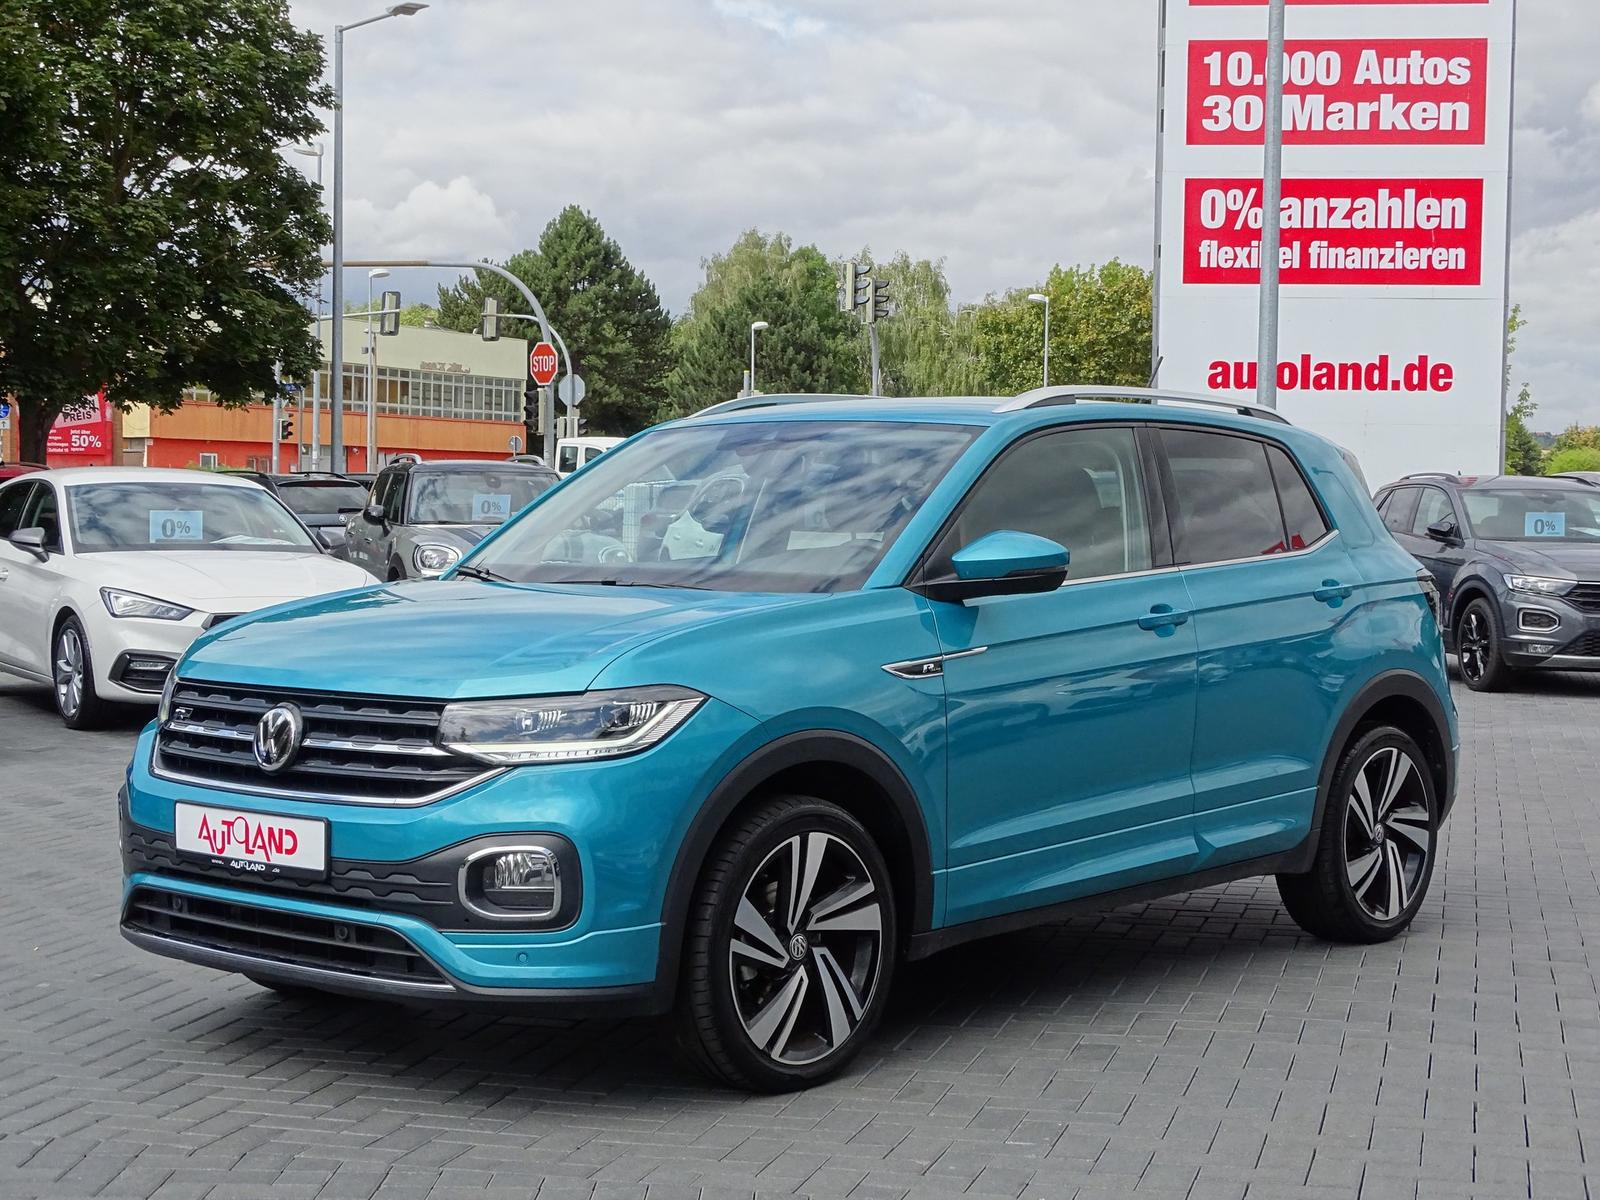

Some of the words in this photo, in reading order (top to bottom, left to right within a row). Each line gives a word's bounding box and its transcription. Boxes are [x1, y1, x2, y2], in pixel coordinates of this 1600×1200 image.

[1353, 49, 1471, 85] Autos
[1202, 94, 1263, 131] 30
[1281, 94, 1470, 131] Marken
[1200, 187, 1263, 230] 0%
[1280, 188, 1467, 229] anzahlen
[1199, 240, 1300, 268] flexiel
[1309, 240, 1466, 270] finanzieren
[532, 355, 555, 372] STOP
[1207, 353, 1454, 391] auoland.de
[71, 435, 102, 448] 50%
[481, 500, 502, 514] 0%
[161, 518, 191, 538] 0%
[1534, 519, 1556, 535] 0%
